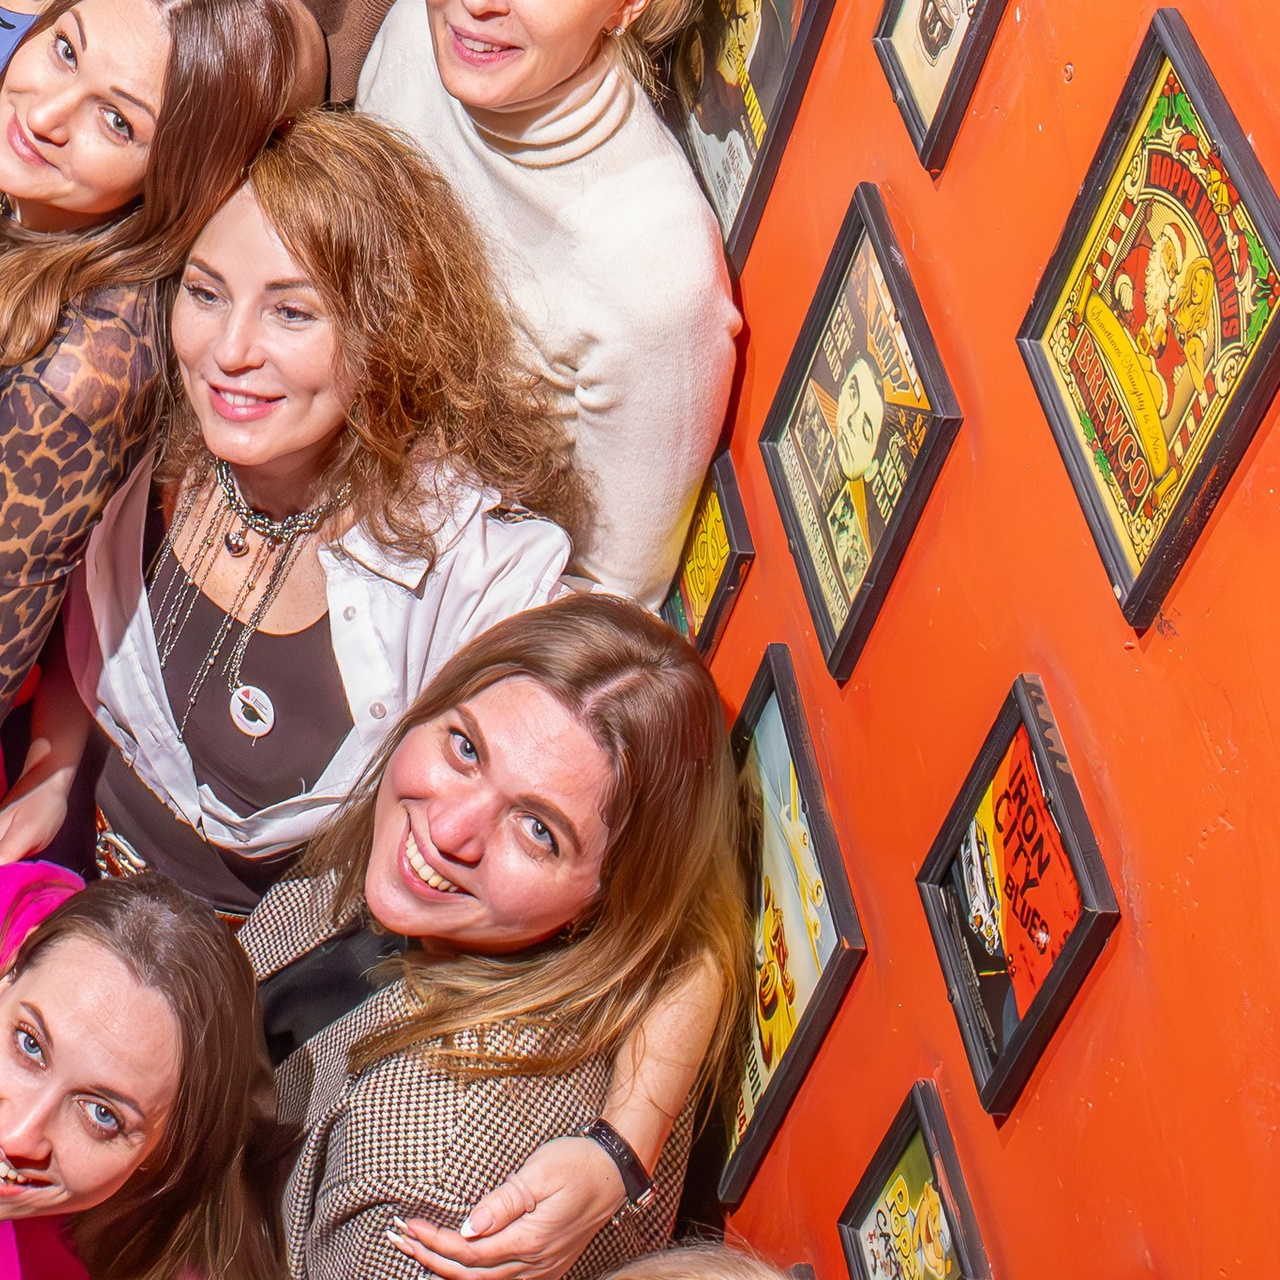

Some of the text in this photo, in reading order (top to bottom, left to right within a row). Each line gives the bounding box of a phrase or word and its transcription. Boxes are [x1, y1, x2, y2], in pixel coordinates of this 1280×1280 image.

[1149, 154, 1238, 338] HOPPY HOLIDAYS
[822, 330, 842, 383] CLUB
[831, 305, 852, 362] CAT
[1089, 304, 1165, 466] Sometimes Naughty is Nice
[1074, 331, 1149, 497] BREWCO
[872, 473, 893, 527] CLU
[994, 788, 1040, 900] CITY
[1008, 759, 1051, 880] IRON
